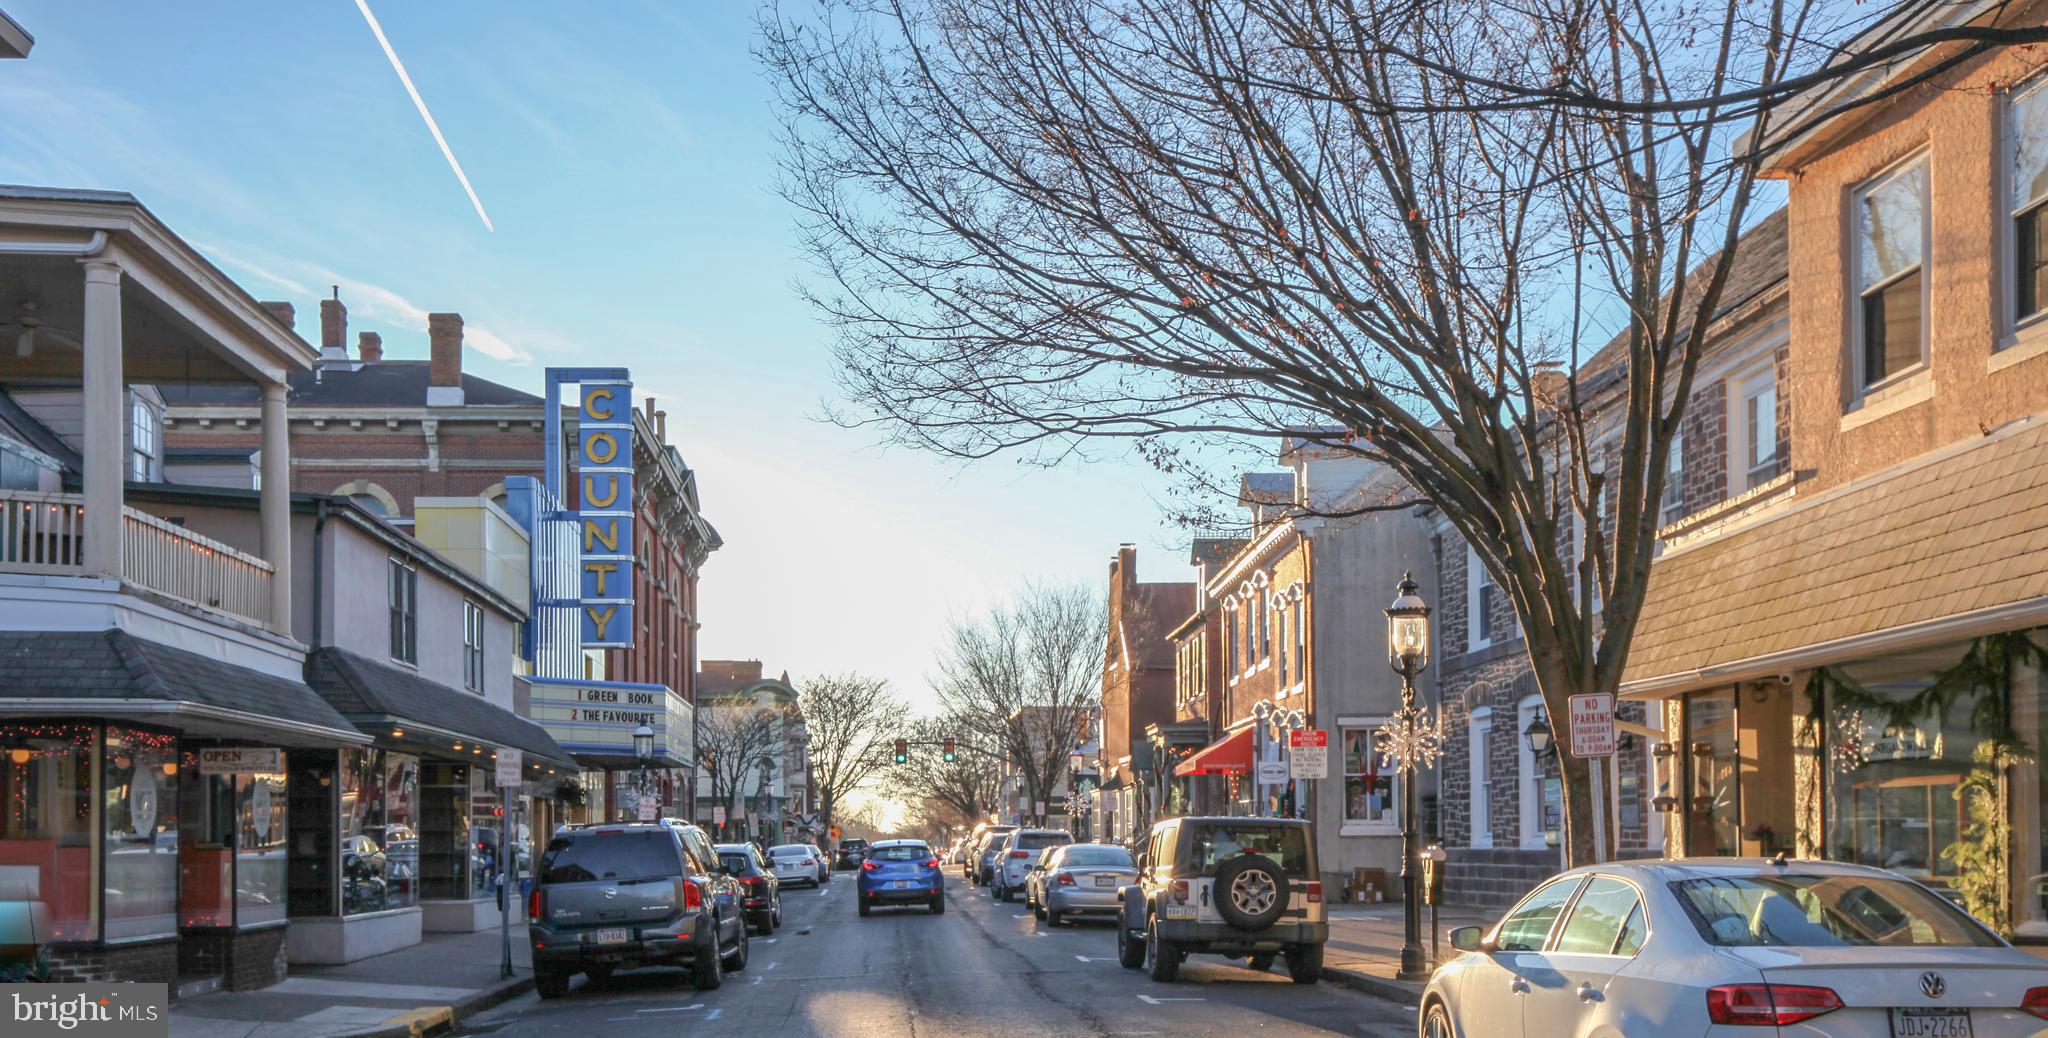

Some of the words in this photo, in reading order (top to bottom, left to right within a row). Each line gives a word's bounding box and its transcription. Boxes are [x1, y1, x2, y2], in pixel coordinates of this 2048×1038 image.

[585, 388, 618, 641] COUNTY
[587, 690, 618, 702] GREEN
[628, 692, 653, 705] BOOK
[1584, 698, 1598, 710] NO
[571, 709, 577, 720] 2
[583, 710, 600, 721] THE
[1574, 712, 1610, 725] PARKING
[1575, 726, 1610, 736] THURSDAY
[203, 751, 242, 762] OPEN
[503, 751, 514, 760] NO
